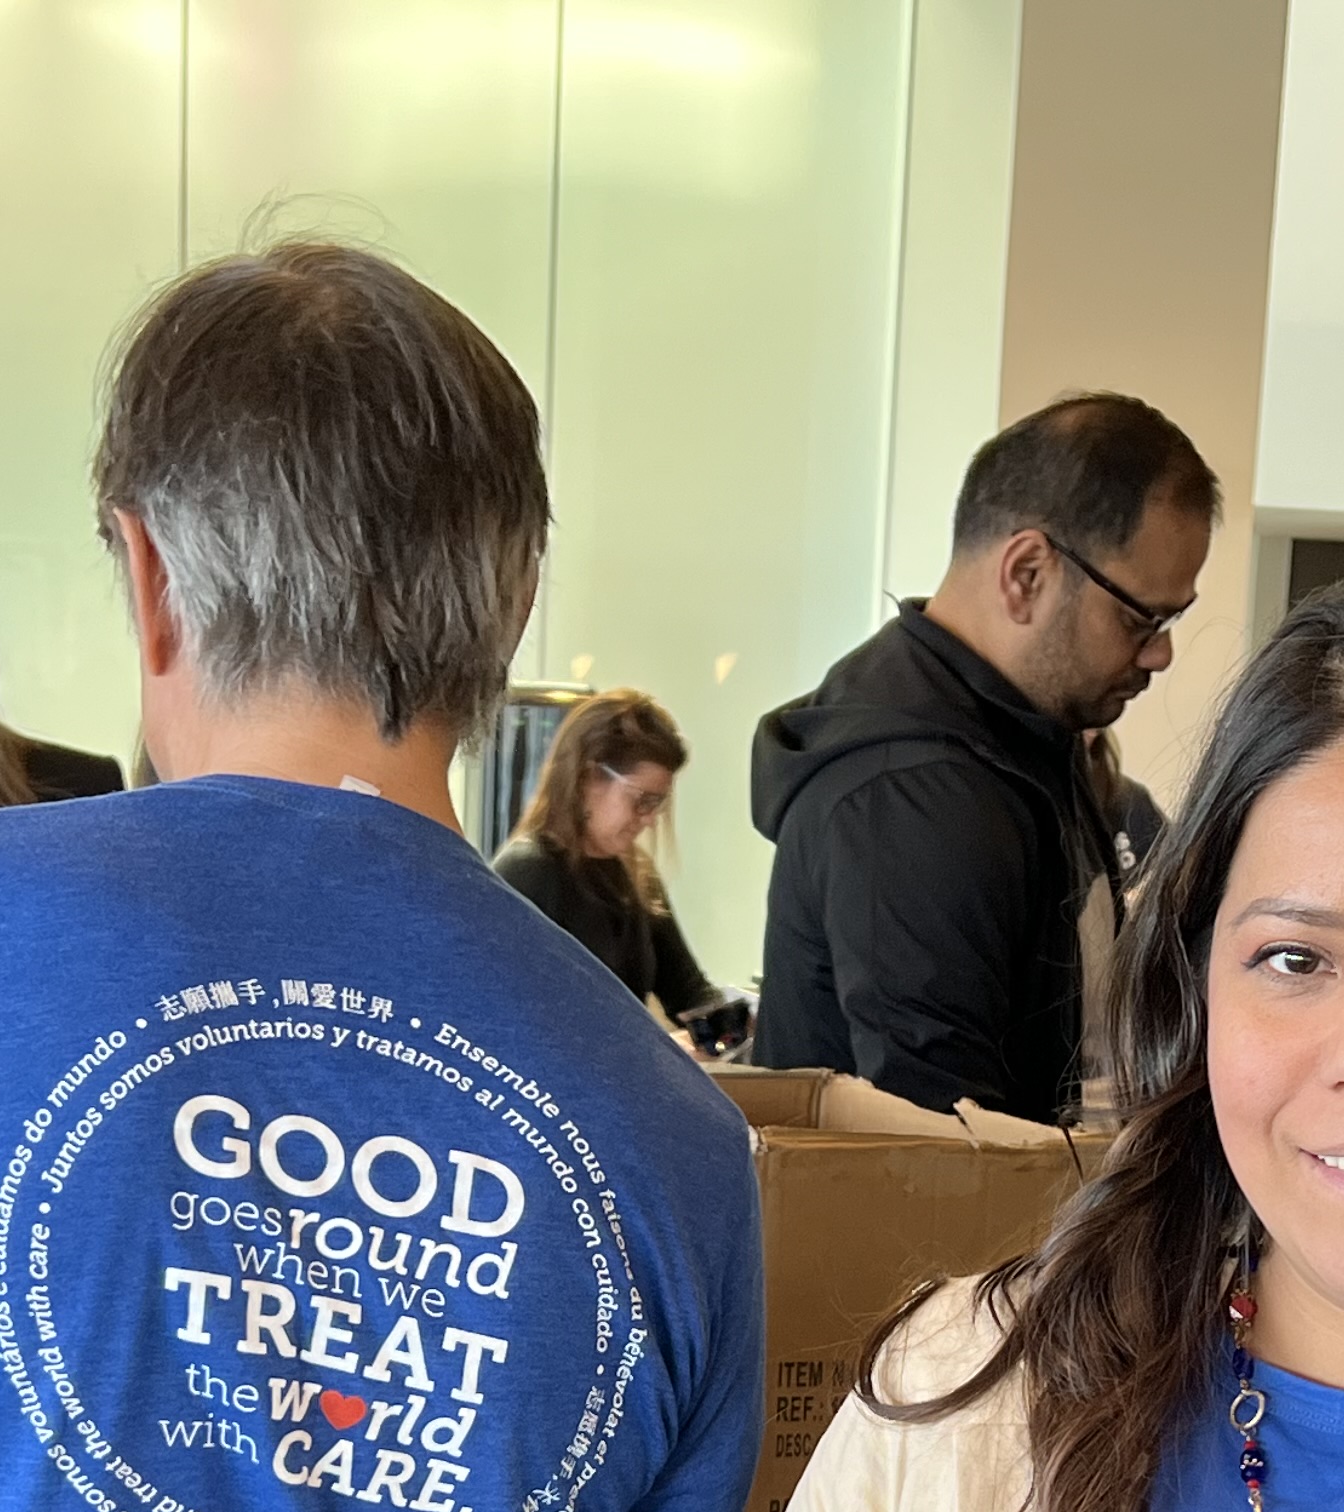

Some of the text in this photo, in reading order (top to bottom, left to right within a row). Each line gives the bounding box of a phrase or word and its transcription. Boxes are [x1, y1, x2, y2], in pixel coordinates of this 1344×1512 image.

[23, 1107, 53, 1144] do
[46, 1030, 128, 1109] mundo
[433, 1023, 560, 1118] Ensemble
[40, 1016, 620, 1353] Juntos somos voluntarios y tratamos al mundo con cuidado
[173, 1094, 525, 1238] GOOD
[559, 1120, 606, 1185] nous
[29, 1222, 51, 1280] care
[169, 1191, 519, 1299] goes round
[598, 1188, 635, 1281] faisons
[25, 1285, 57, 1342] with
[233, 1241, 446, 1318] when we
[629, 1286, 644, 1321] du
[164, 1266, 508, 1404] TREAT
[38, 1346, 85, 1420] world
[185, 1363, 260, 1413] the
[603, 1327, 649, 1438] bénévolat
[777, 1361, 824, 1388] ITEM
[76, 1419, 112, 1460] the
[158, 1413, 260, 1465] with
[594, 1439, 608, 1466] et
[105, 1456, 158, 1504] treat
